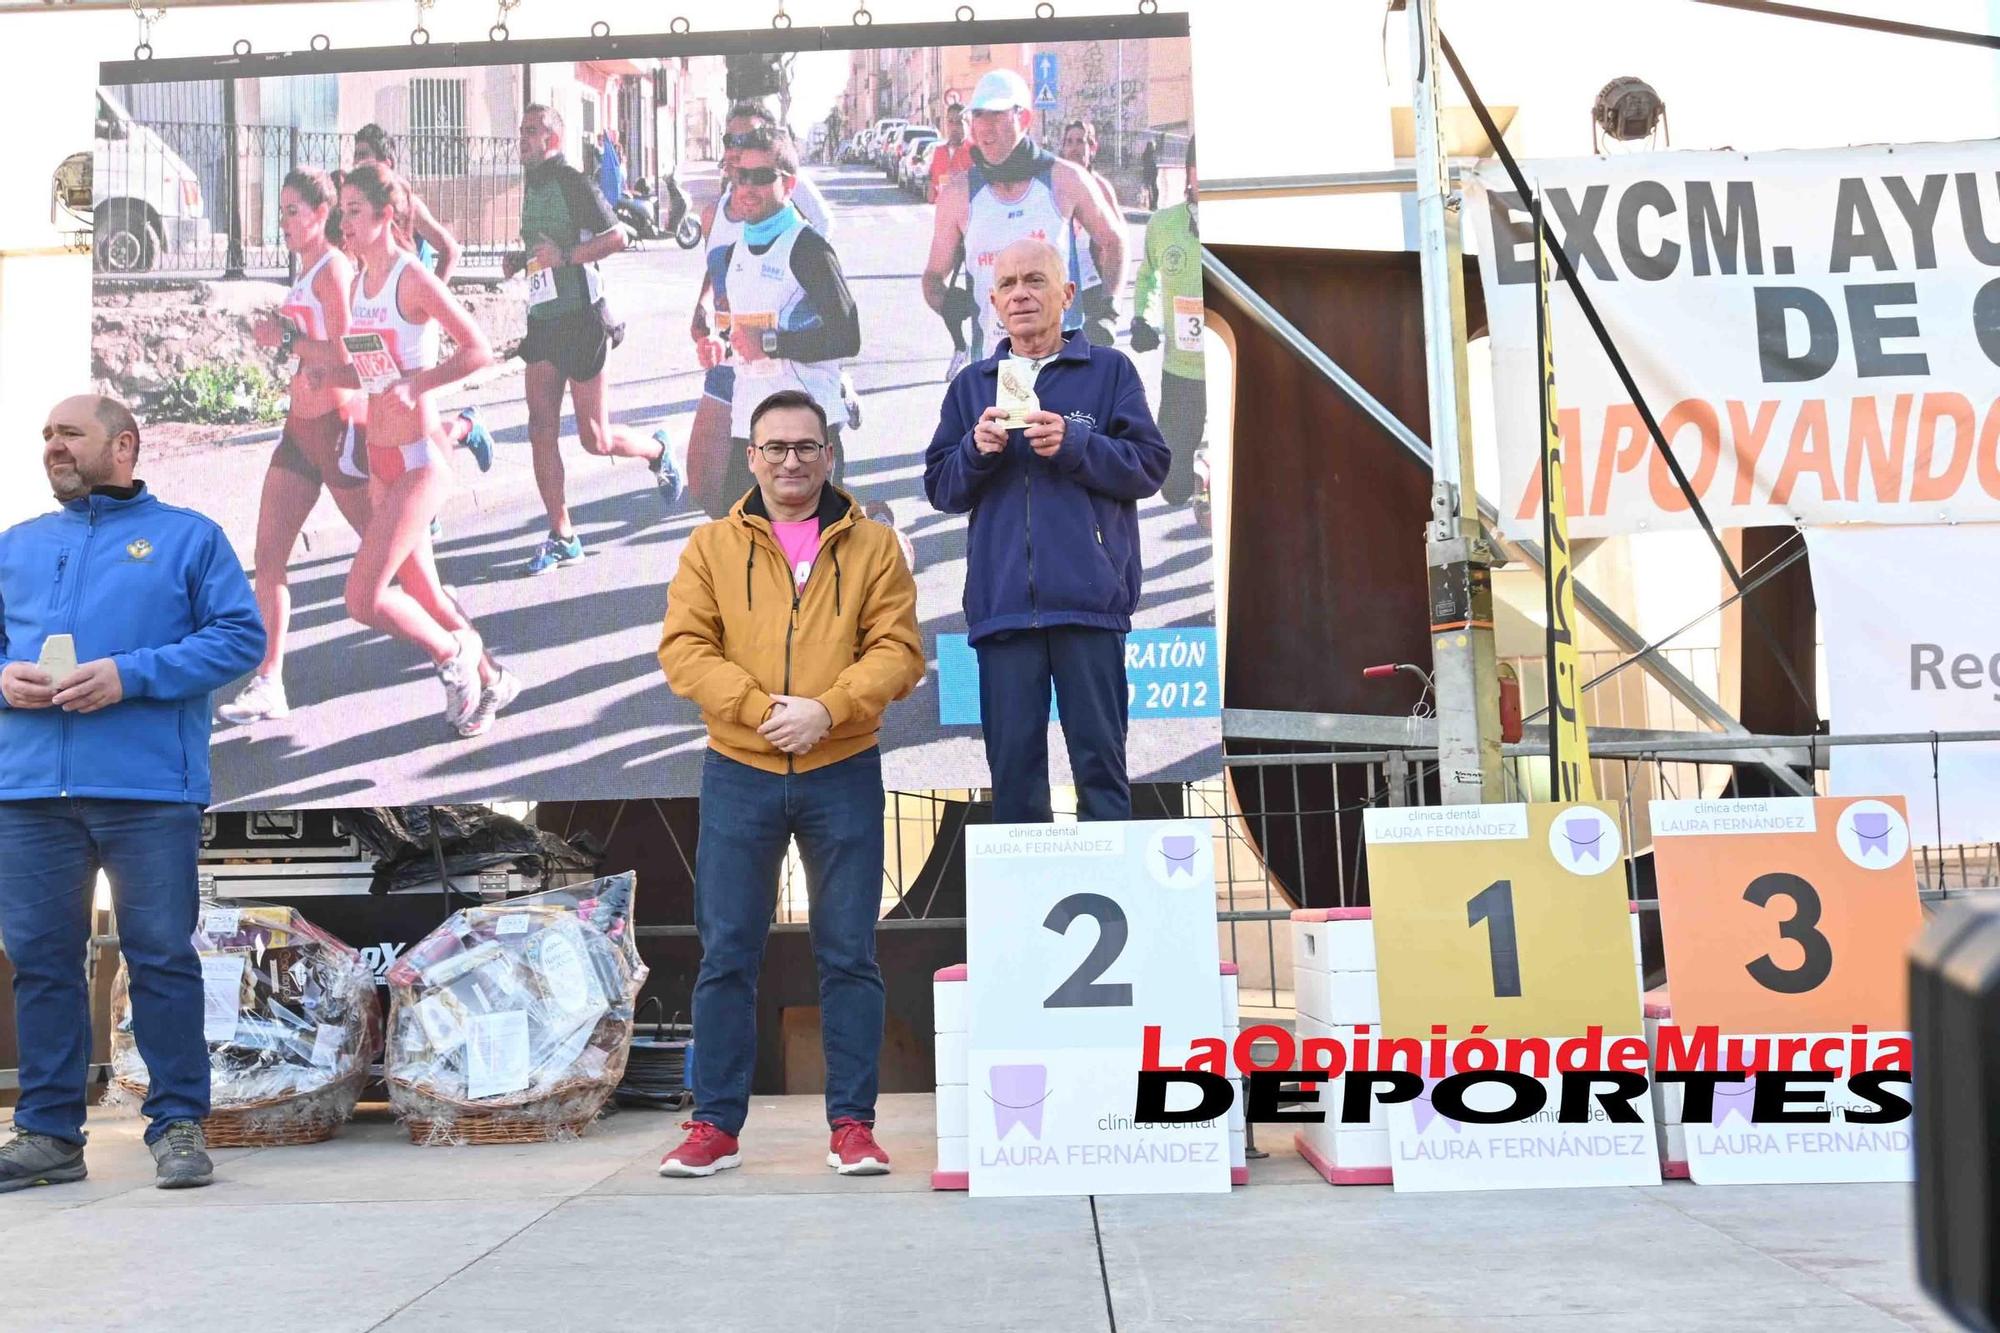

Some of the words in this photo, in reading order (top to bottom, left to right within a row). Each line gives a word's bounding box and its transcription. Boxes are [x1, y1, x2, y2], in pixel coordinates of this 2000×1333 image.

[1486, 179, 1796, 285] EXCM.
[1753, 282, 1931, 384] DE
[1145, 681, 1208, 709] 2012
[1408, 809, 1443, 822] clínica
[1446, 808, 1481, 820] dental
[1694, 802, 1730, 815] clínica
[1733, 800, 1769, 813] dental
[1008, 826, 1042, 838] clínica
[1045, 825, 1079, 837] dental
[1375, 827, 1424, 840] LAURA
[1426, 823, 1518, 838] FERNÁNDEZ
[1661, 819, 1710, 832] LAURA
[1713, 816, 1806, 831] FERNÁNDEZ
[975, 843, 1023, 856] LAURA
[1025, 839, 1113, 854] FERNÁNDEZ
[1466, 879, 1522, 997] 1
[1742, 872, 1833, 994] 3
[1042, 892, 1134, 1009] 2
[979, 1146, 1061, 1167] LAURA
[1066, 1138, 1220, 1166] FERNÁNDEZ
[1400, 1139, 1483, 1161] LAURA
[1488, 1131, 1647, 1159] FERNÁNDEZ
[1697, 1133, 1782, 1155] LAURA
